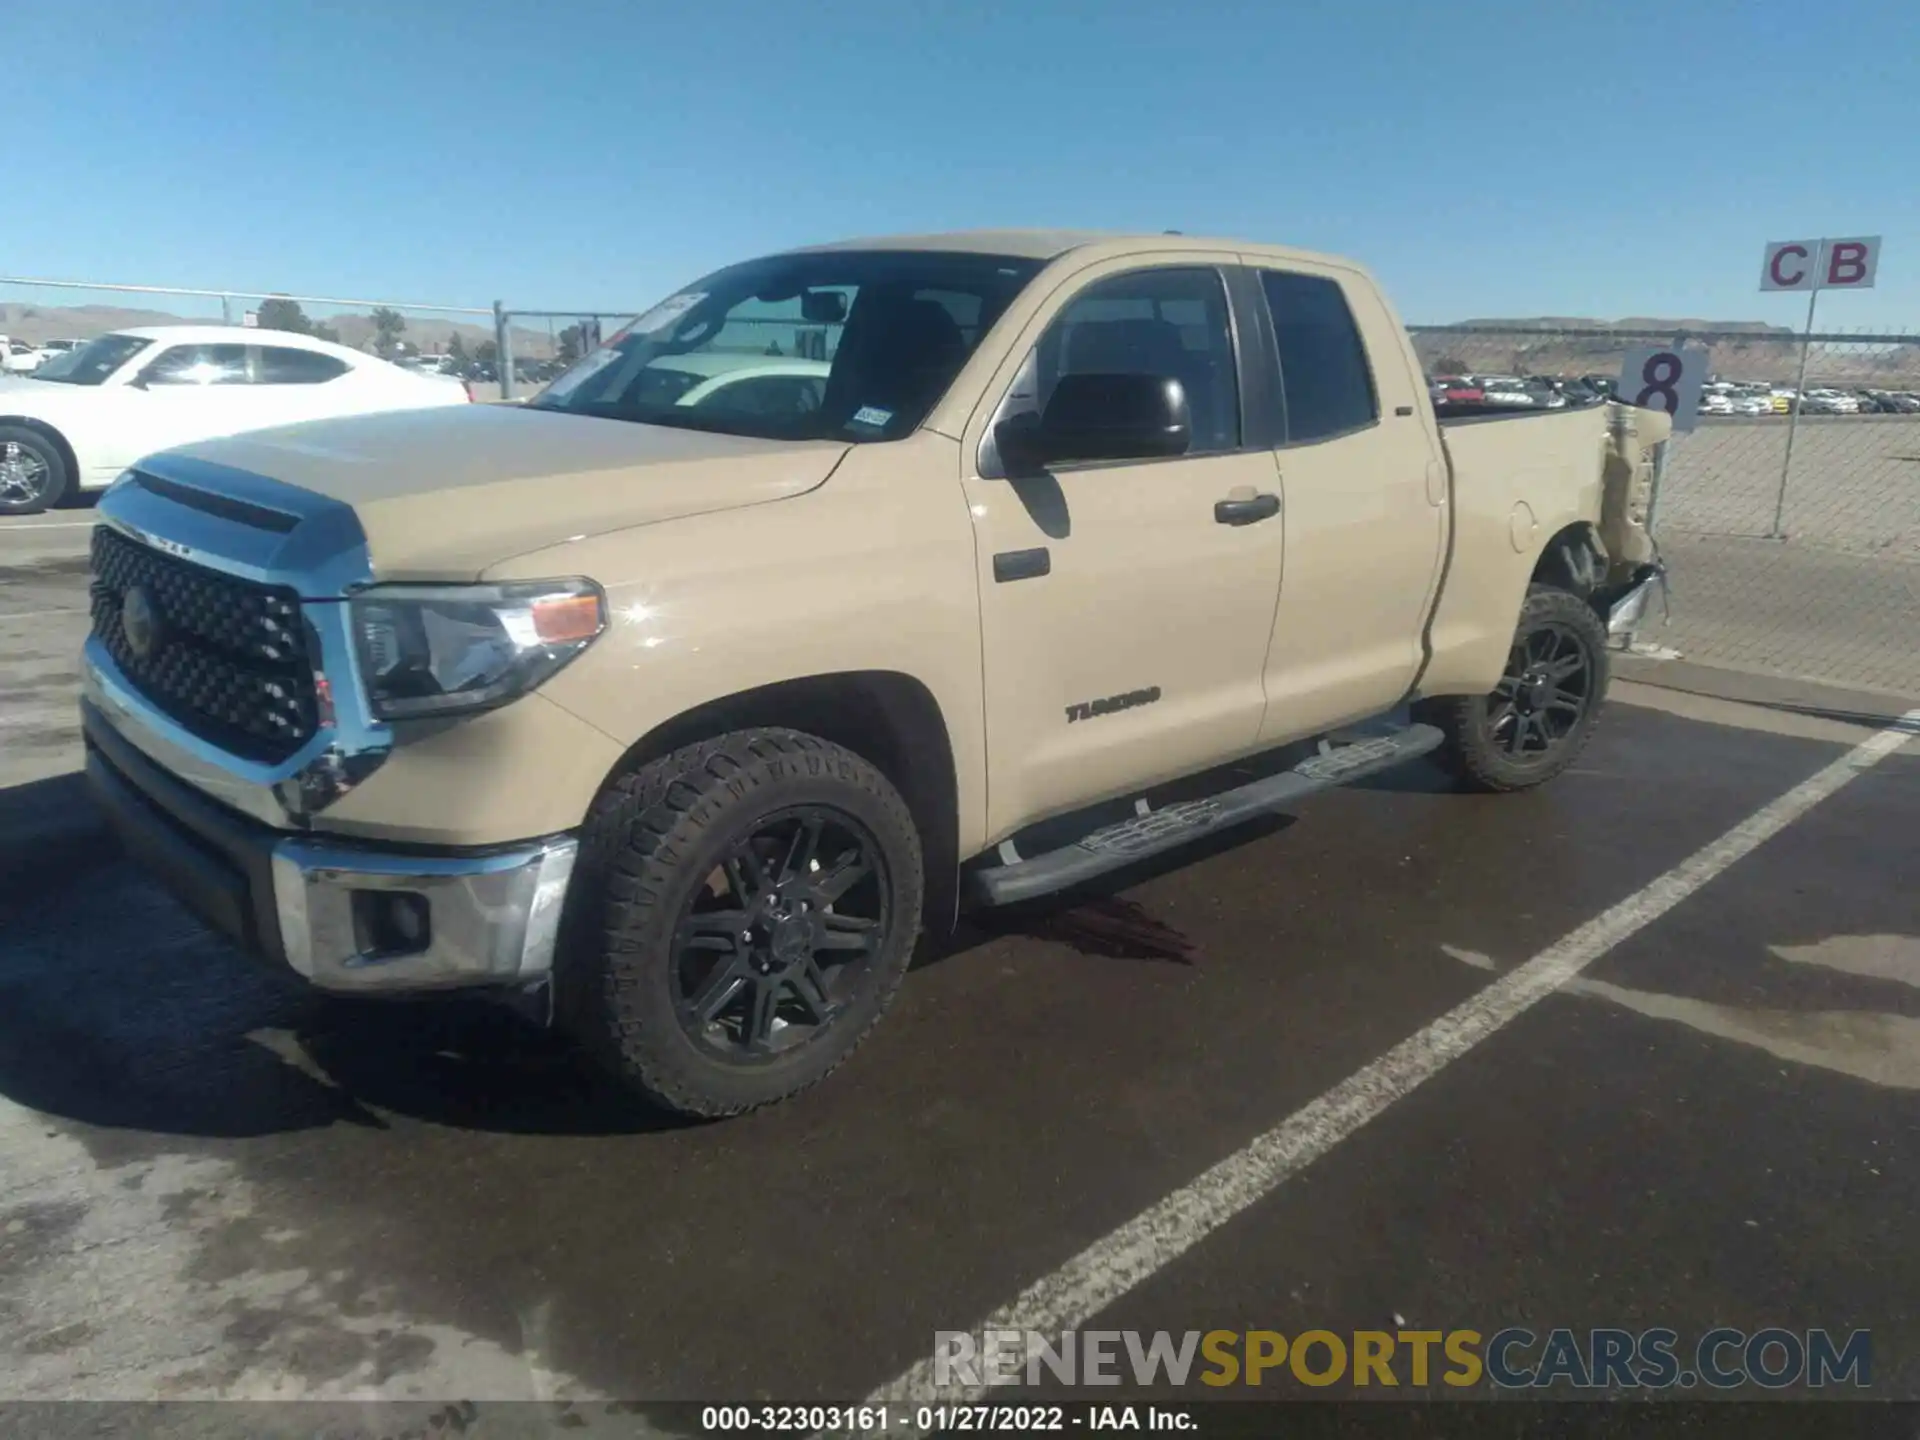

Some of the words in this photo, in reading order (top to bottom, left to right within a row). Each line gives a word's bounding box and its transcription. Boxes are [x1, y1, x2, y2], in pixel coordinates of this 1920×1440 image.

[1771, 245, 1808, 286] C
[1828, 242, 1867, 284] B
[1636, 352, 1682, 417] 8
